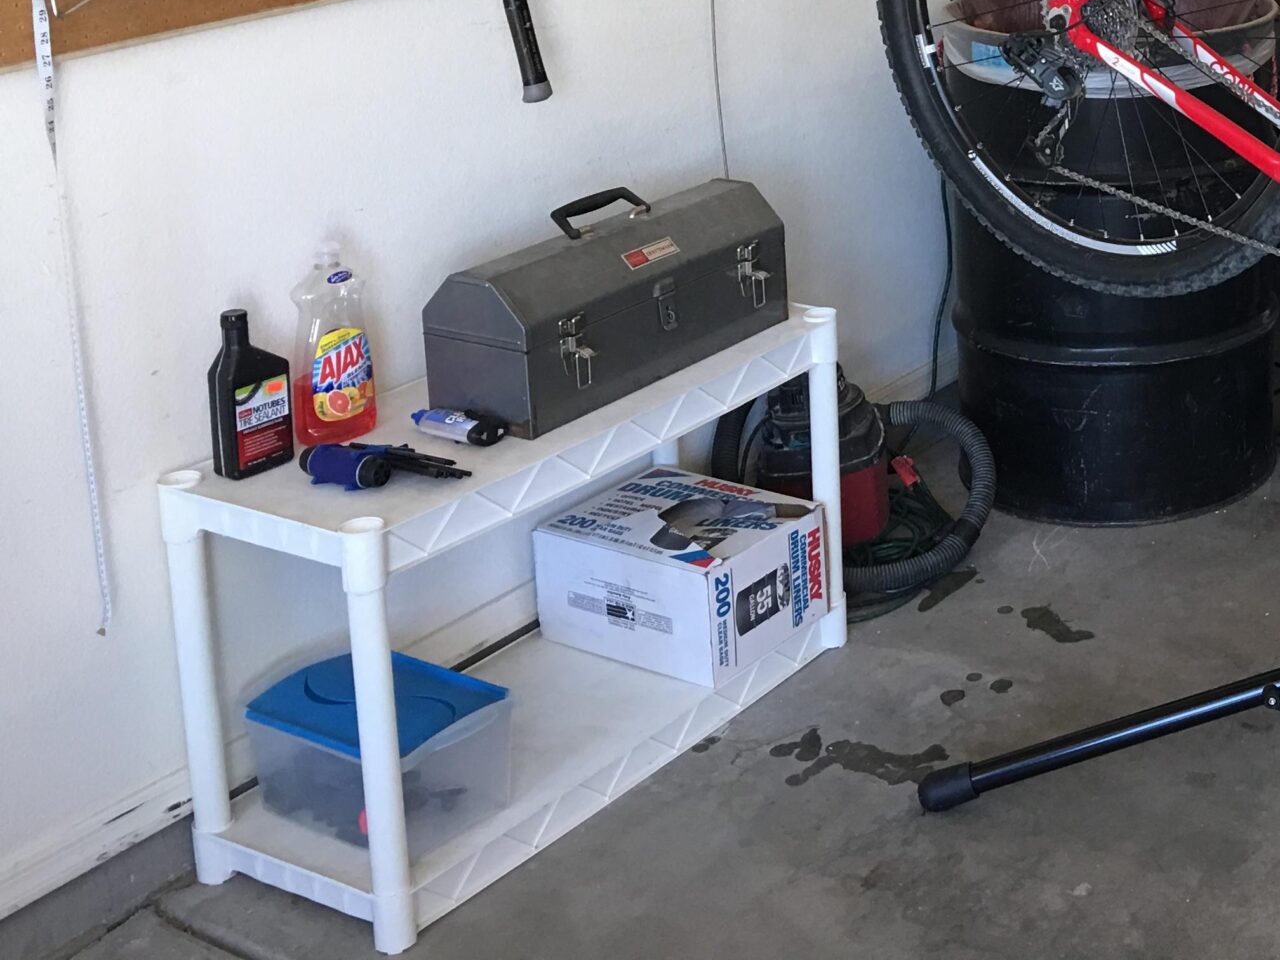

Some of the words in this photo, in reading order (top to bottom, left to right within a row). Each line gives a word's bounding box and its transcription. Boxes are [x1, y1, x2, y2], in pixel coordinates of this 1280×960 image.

[318, 337, 367, 387] AJAX
[240, 416, 254, 429] TIRE
[255, 405, 287, 423] SEALANT
[253, 397, 286, 414] NOTUBES
[617, 482, 696, 502] DRUM
[694, 479, 755, 496] HUSKY
[557, 514, 597, 529] 200
[790, 529, 800, 573] DRUM
[807, 526, 823, 602] HUSKY
[799, 533, 810, 613] COMMERCIAL
[714, 572, 731, 618] 200
[748, 594, 756, 622] GALLON
[756, 585, 772, 615] 55
[792, 575, 804, 628] LINERS
